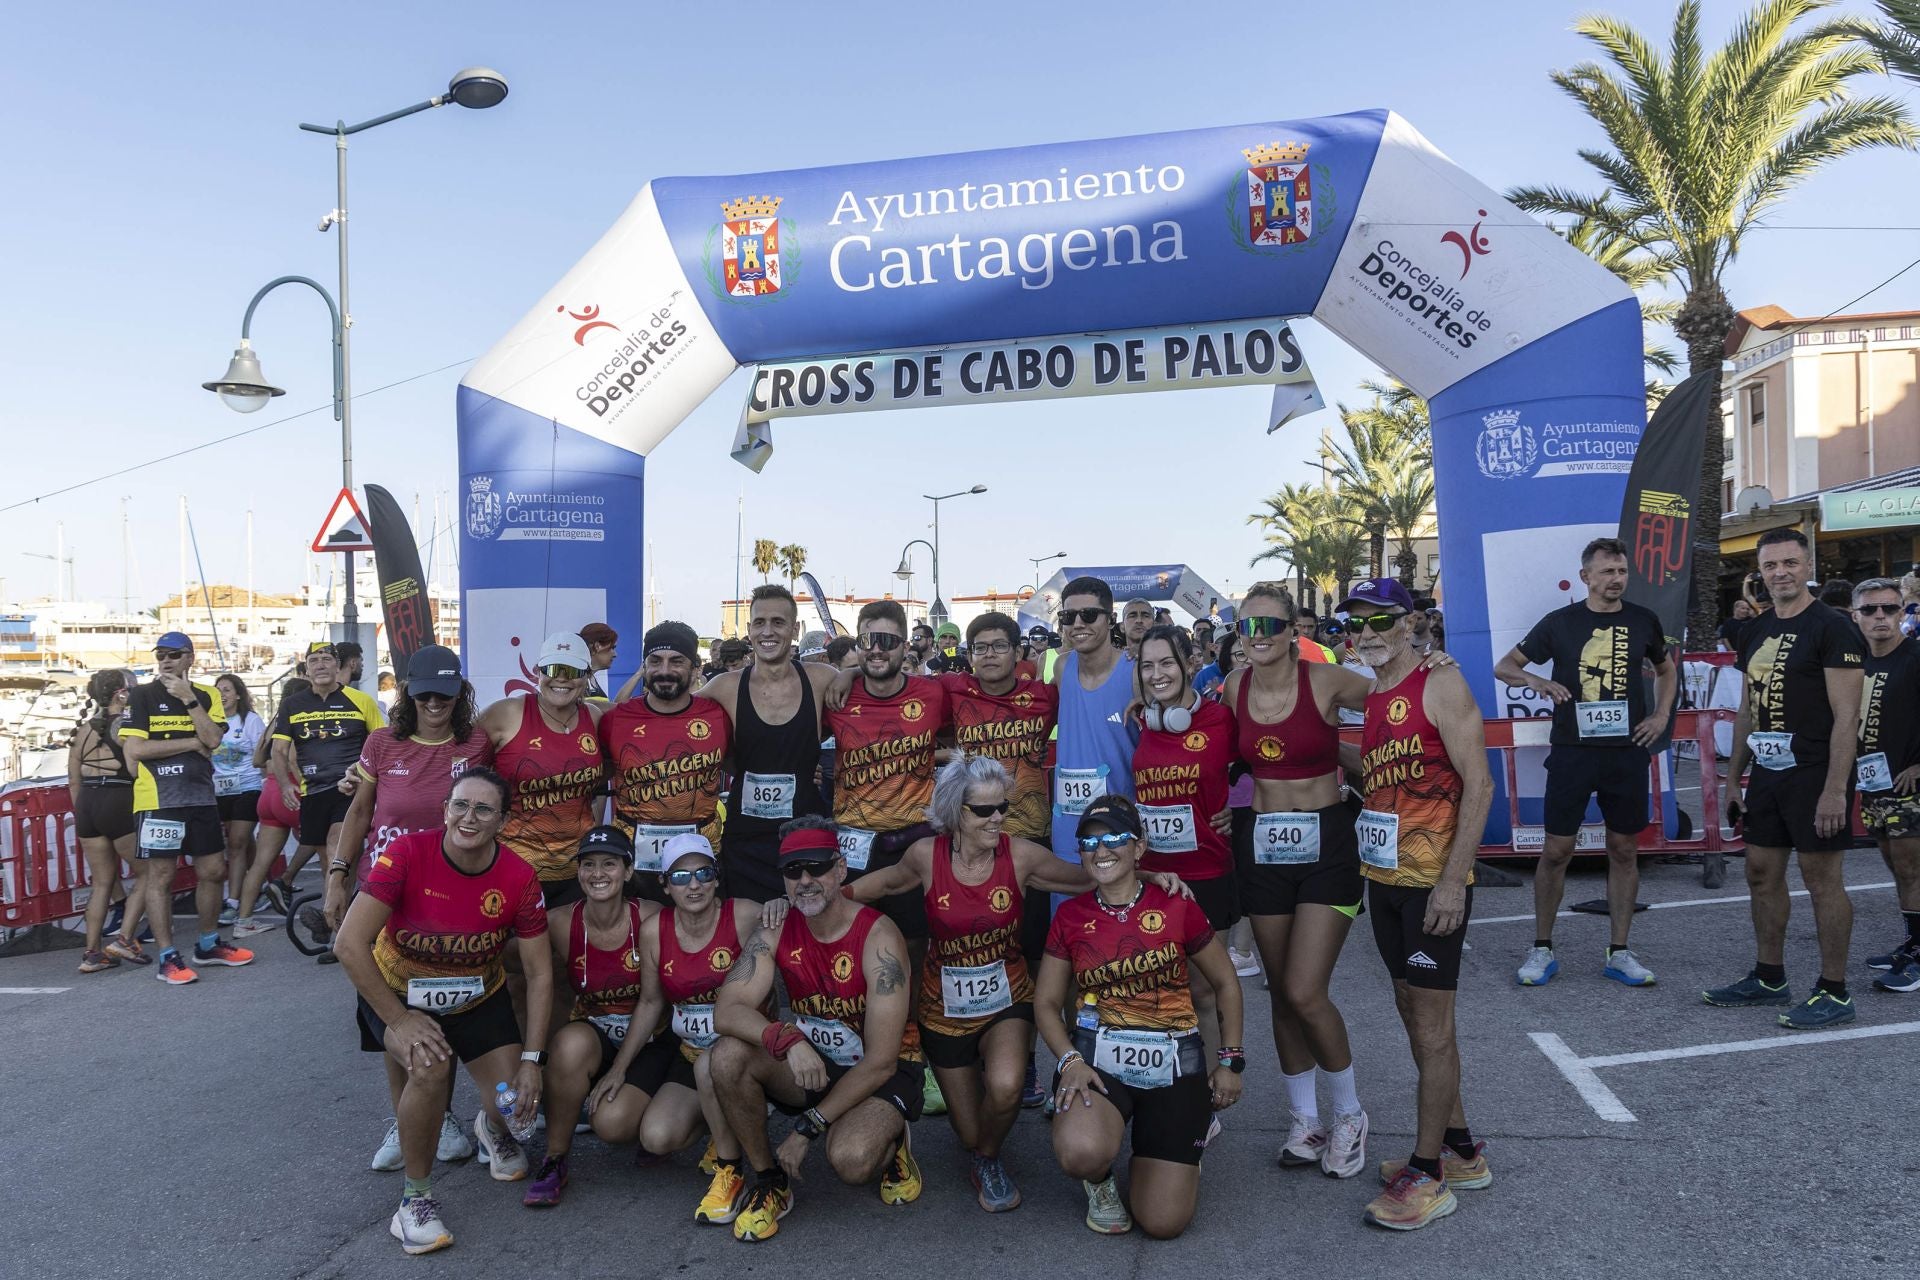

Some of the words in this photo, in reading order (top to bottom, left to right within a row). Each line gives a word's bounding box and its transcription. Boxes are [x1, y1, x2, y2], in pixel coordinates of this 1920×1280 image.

[827, 163, 1187, 234] Ayuntamiento
[829, 219, 1188, 293] Cartagena
[1377, 240, 1465, 312] Concejalía
[1466, 310, 1491, 332] de
[1359, 252, 1478, 348] Deportes
[650, 307, 671, 329] de
[1350, 275, 1404, 318] AYUNTAMIENTO
[1405, 317, 1416, 327] DE
[1417, 326, 1460, 360] CARTAGENA
[586, 320, 687, 417] Deportes
[608, 380, 652, 424] AYUNTAMIENTO
[652, 371, 662, 380] DE
[662, 335, 698, 369] CARTAGENA
[749, 359, 876, 414] CROSS
[892, 352, 944, 403] DE
[959, 344, 1076, 395] CABO
[1092, 337, 1148, 384] DE
[1163, 325, 1304, 381] PALOS
[1542, 420, 1640, 438] Ayuntamiento
[506, 491, 605, 510] Ayuntamiento
[1844, 500, 1871, 515] LA
[505, 506, 605, 528] Cartagena
[522, 528, 603, 540] www.cartagena.es
[1109, 581, 1151, 593] rtagena
[1613, 626, 1629, 700] FARKASFAL
[1844, 653, 1861, 663] HUN
[1769, 633, 1798, 731] FARKASFALK
[1586, 710, 1622, 723] 1435
[1864, 672, 1889, 752] FARKASFAL
[956, 716, 1044, 744] CARTAGENA
[842, 729, 932, 769] CARTAGENA
[157, 764, 185, 776] UPCT
[519, 762, 604, 794] CARTAGEN
[623, 747, 722, 787] CARTAGENA
[845, 751, 929, 789] RUNNING
[218, 778, 234, 788] 718
[628, 767, 719, 807] RUNNING
[754, 787, 782, 802] 862
[1065, 782, 1092, 797] 918
[1137, 782, 1197, 803] UNNING
[149, 828, 179, 839] 1388
[1142, 817, 1184, 834] 1179
[1268, 827, 1302, 844] 540
[1360, 825, 1387, 847] 1150
[395, 927, 510, 954] CARTAGEN
[939, 918, 1018, 956] CARTAGENA
[1076, 942, 1179, 989] CARTAGENA
[954, 975, 999, 998] 1125
[422, 991, 473, 1006] 1077
[811, 1027, 845, 1047] 605
[1112, 1045, 1164, 1068] 1200
[1123, 1067, 1151, 1077] JULIETA
